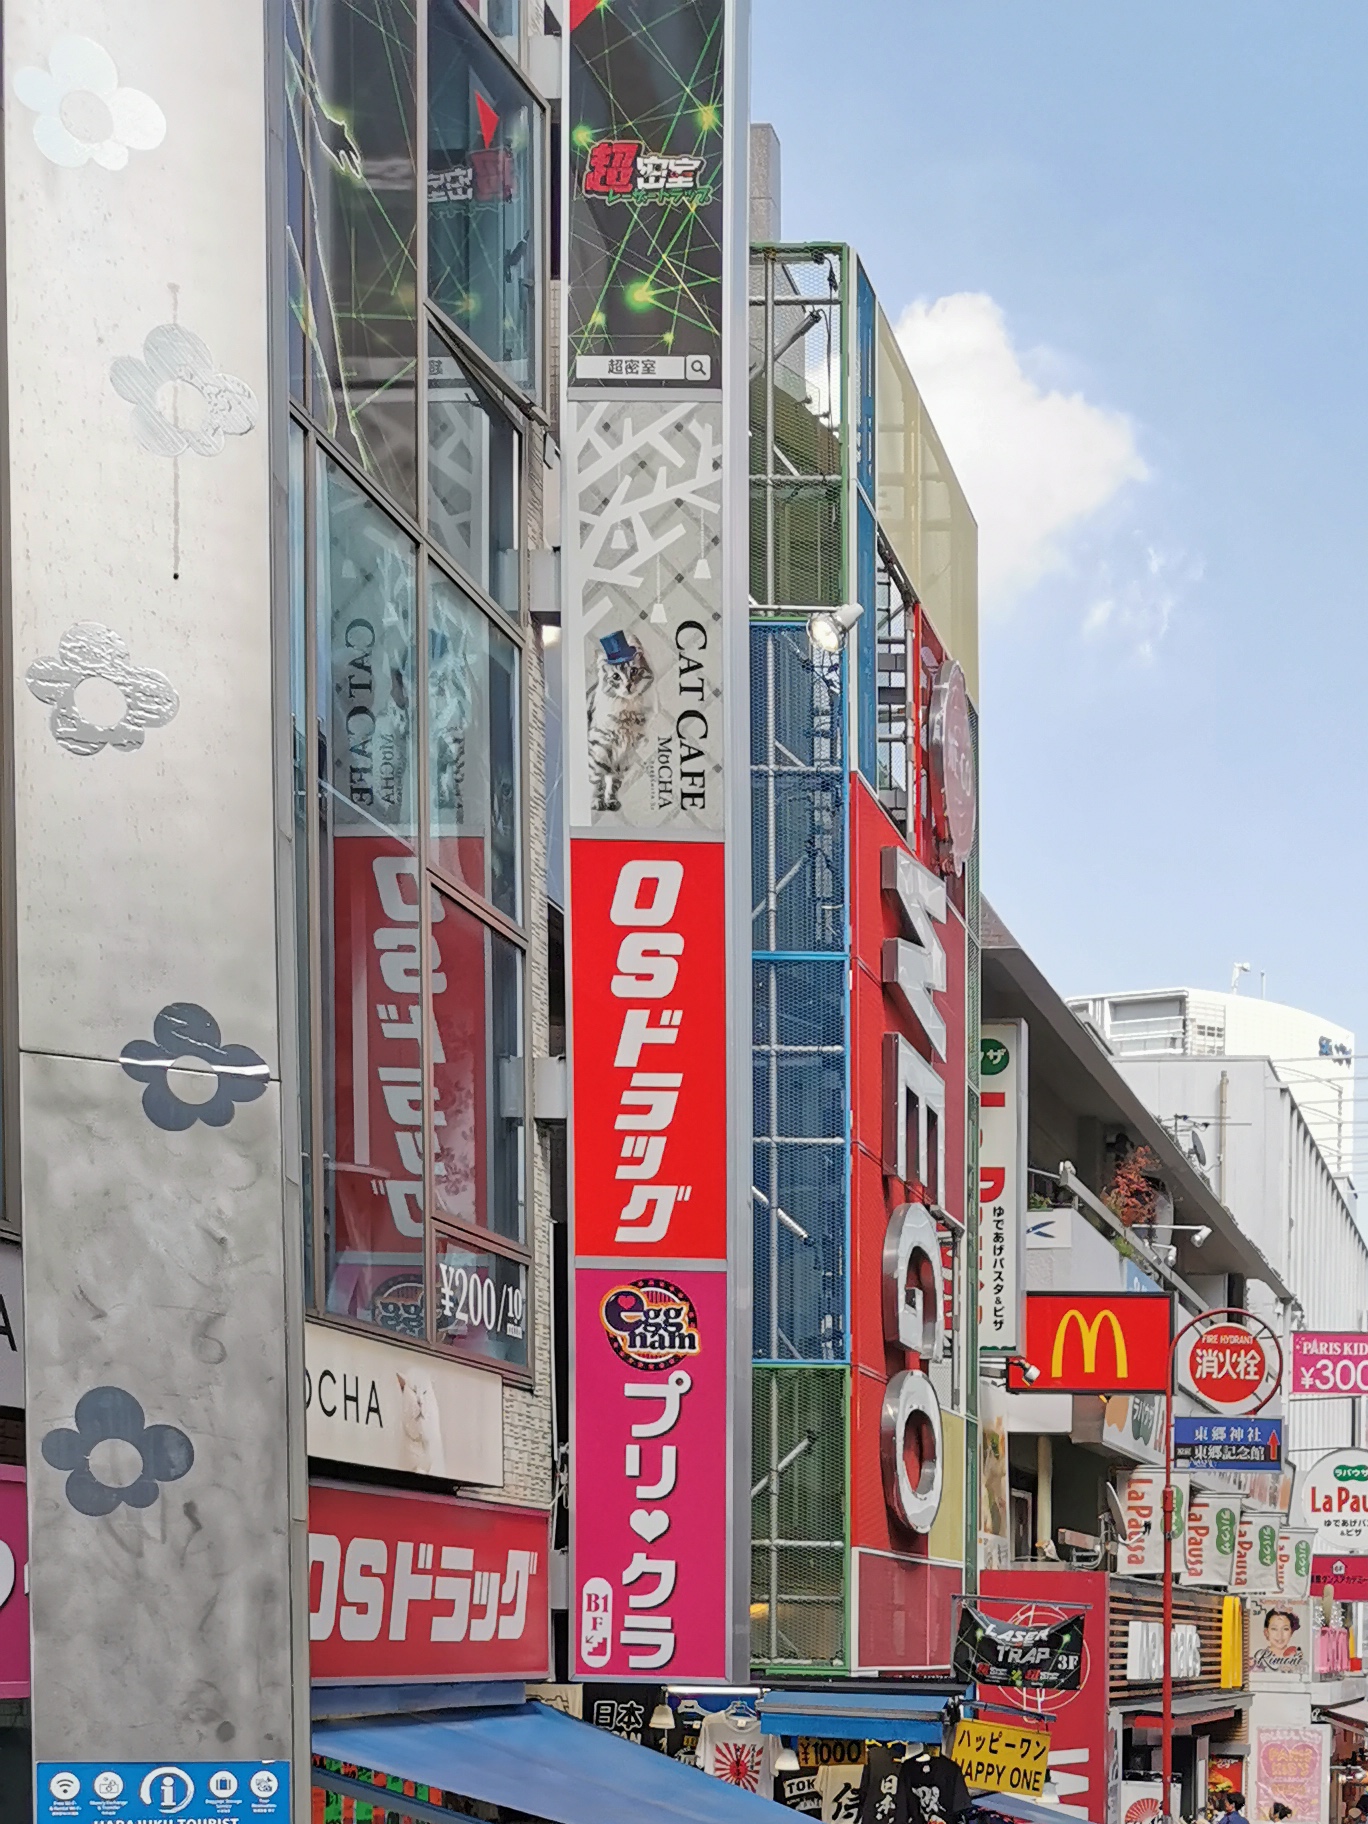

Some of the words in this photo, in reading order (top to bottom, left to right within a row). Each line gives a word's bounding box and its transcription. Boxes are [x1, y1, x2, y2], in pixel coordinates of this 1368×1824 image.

[607, 358, 657, 376] 超密室
[675, 620, 708, 702] CAT
[676, 709, 709, 812] CAFE
[609, 860, 693, 1243] OSドラッグ
[1303, 1338, 1341, 1356] PARIS
[1195, 1349, 1261, 1380] 消火栓
[1194, 1426, 1262, 1442] 東郷神社
[1194, 1446, 1265, 1461] 東郷記念館
[1127, 1479, 1153, 1502] La
[1311, 1487, 1332, 1513] La
[1188, 1503, 1209, 1523] La
[1188, 1526, 1210, 1577] Pausa
[585, 1593, 609, 1613] B1
[592, 1616, 604, 1634] F
[985, 1623, 1051, 1642] LASER
[997, 1645, 1051, 1664] TRAP
[1057, 1654, 1079, 1670] 3F
[594, 1701, 645, 1731] 日本
[800, 1738, 862, 1765] ¥1000
[957, 1729, 1047, 1761] ハッピーワン
[787, 1778, 816, 1795] TOK
[1009, 1766, 1043, 1792] ONE
